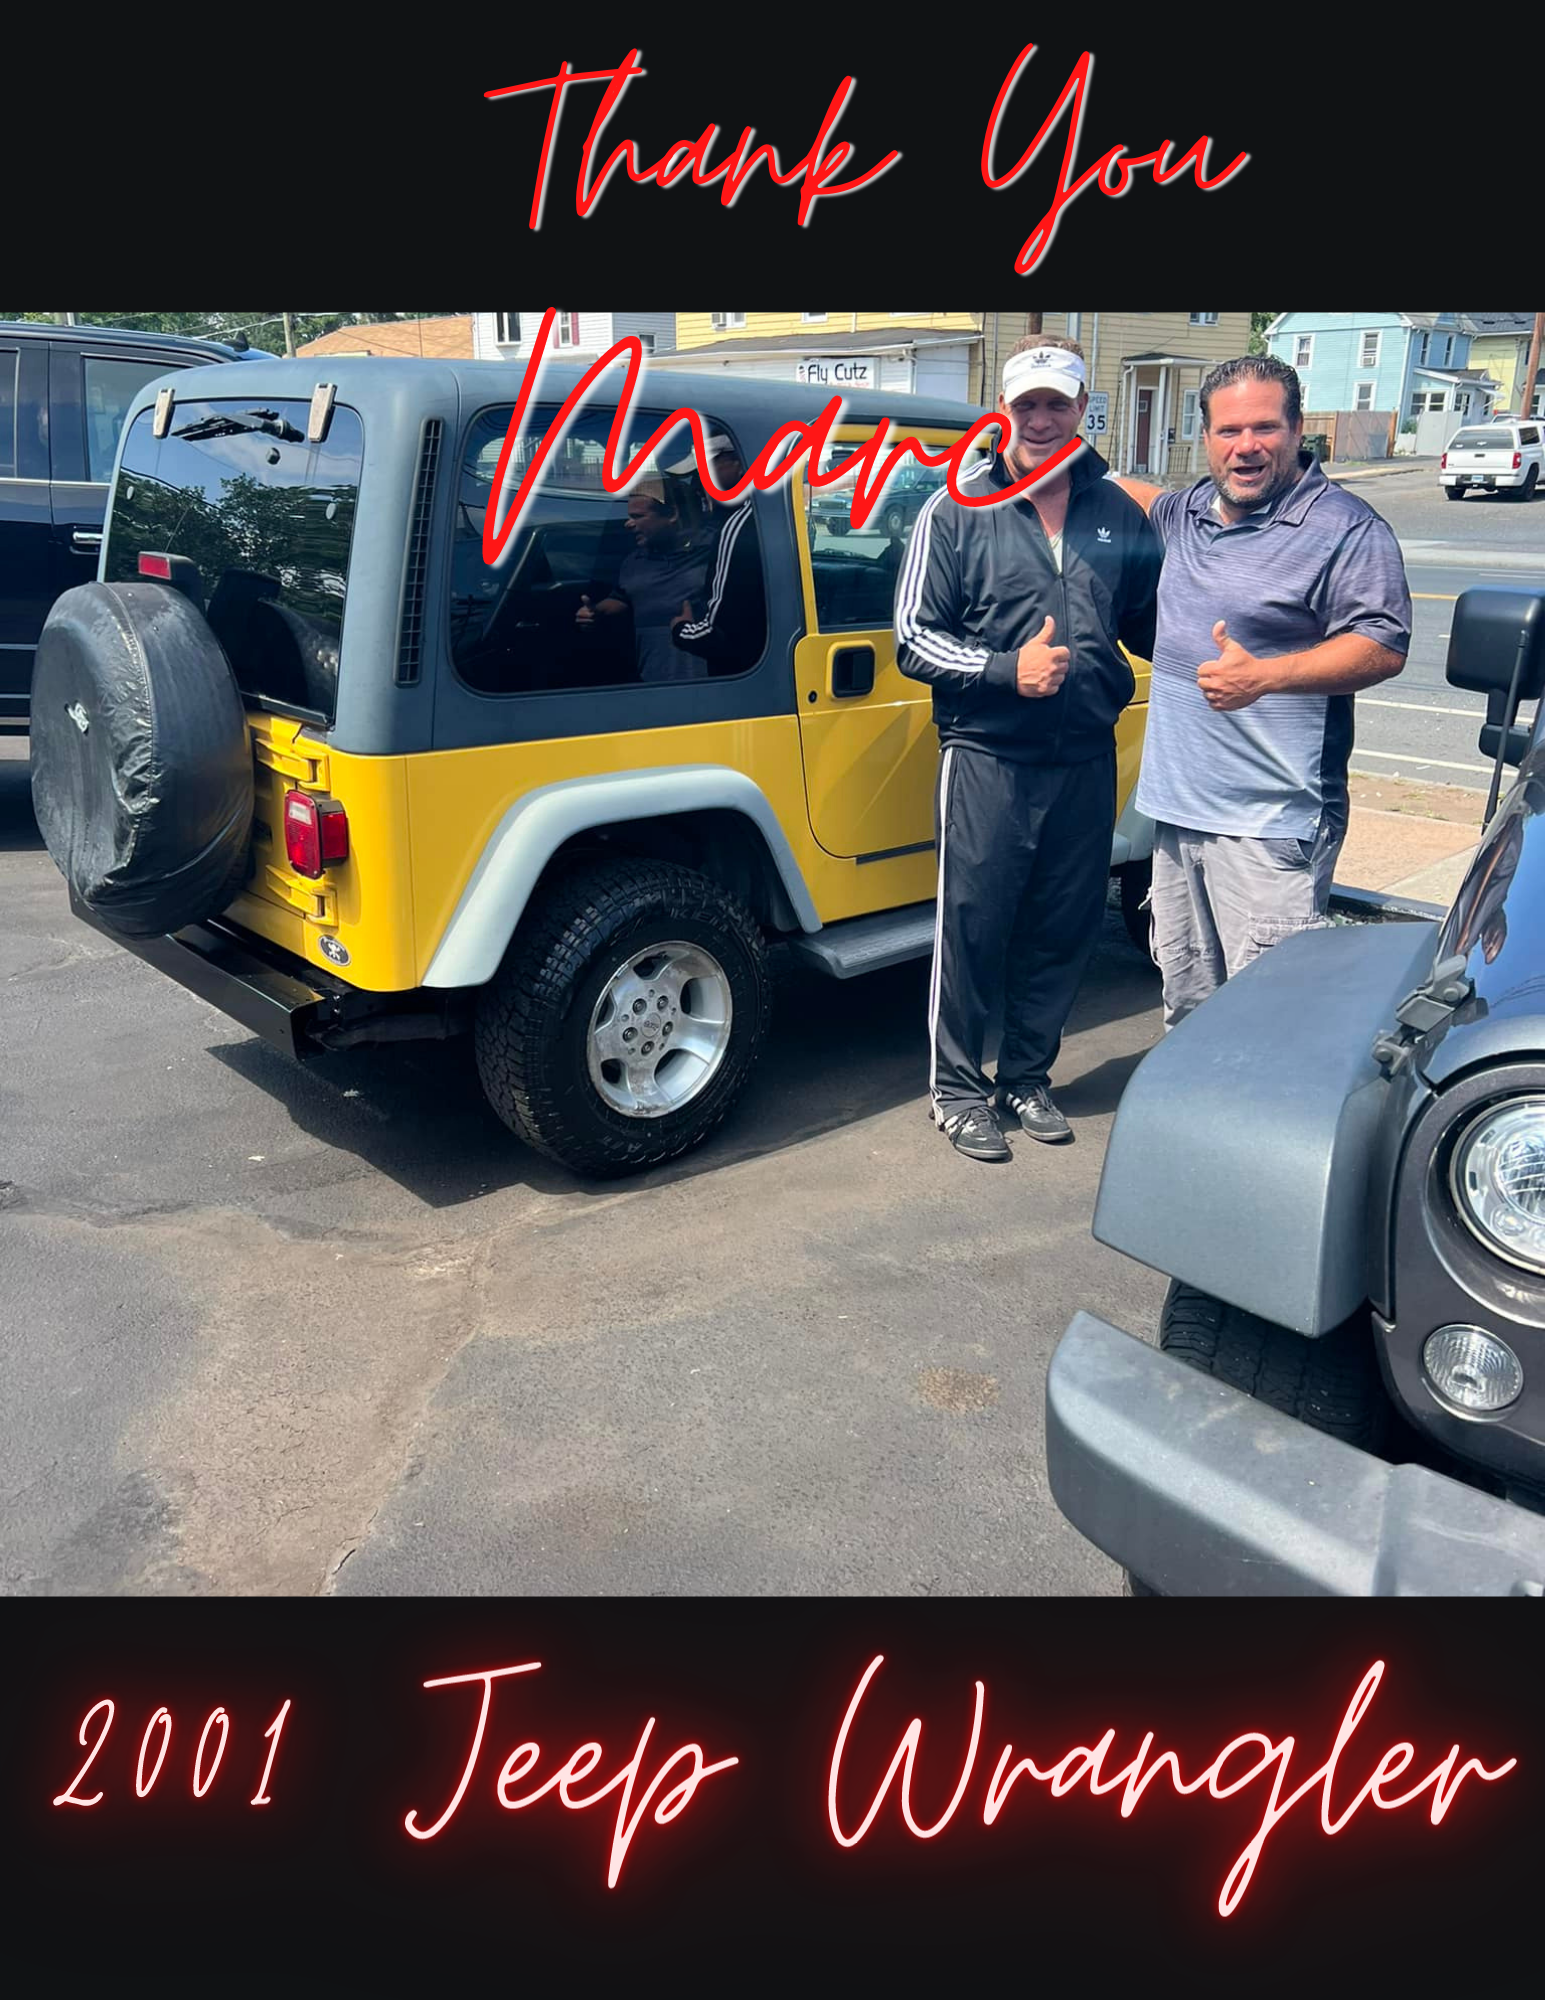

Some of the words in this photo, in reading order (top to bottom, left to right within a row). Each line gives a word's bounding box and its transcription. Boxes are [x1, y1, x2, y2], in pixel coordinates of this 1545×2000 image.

[807, 363, 828, 385] Fly
[834, 361, 867, 381] Cutz
[1087, 414, 1106, 430] 35
